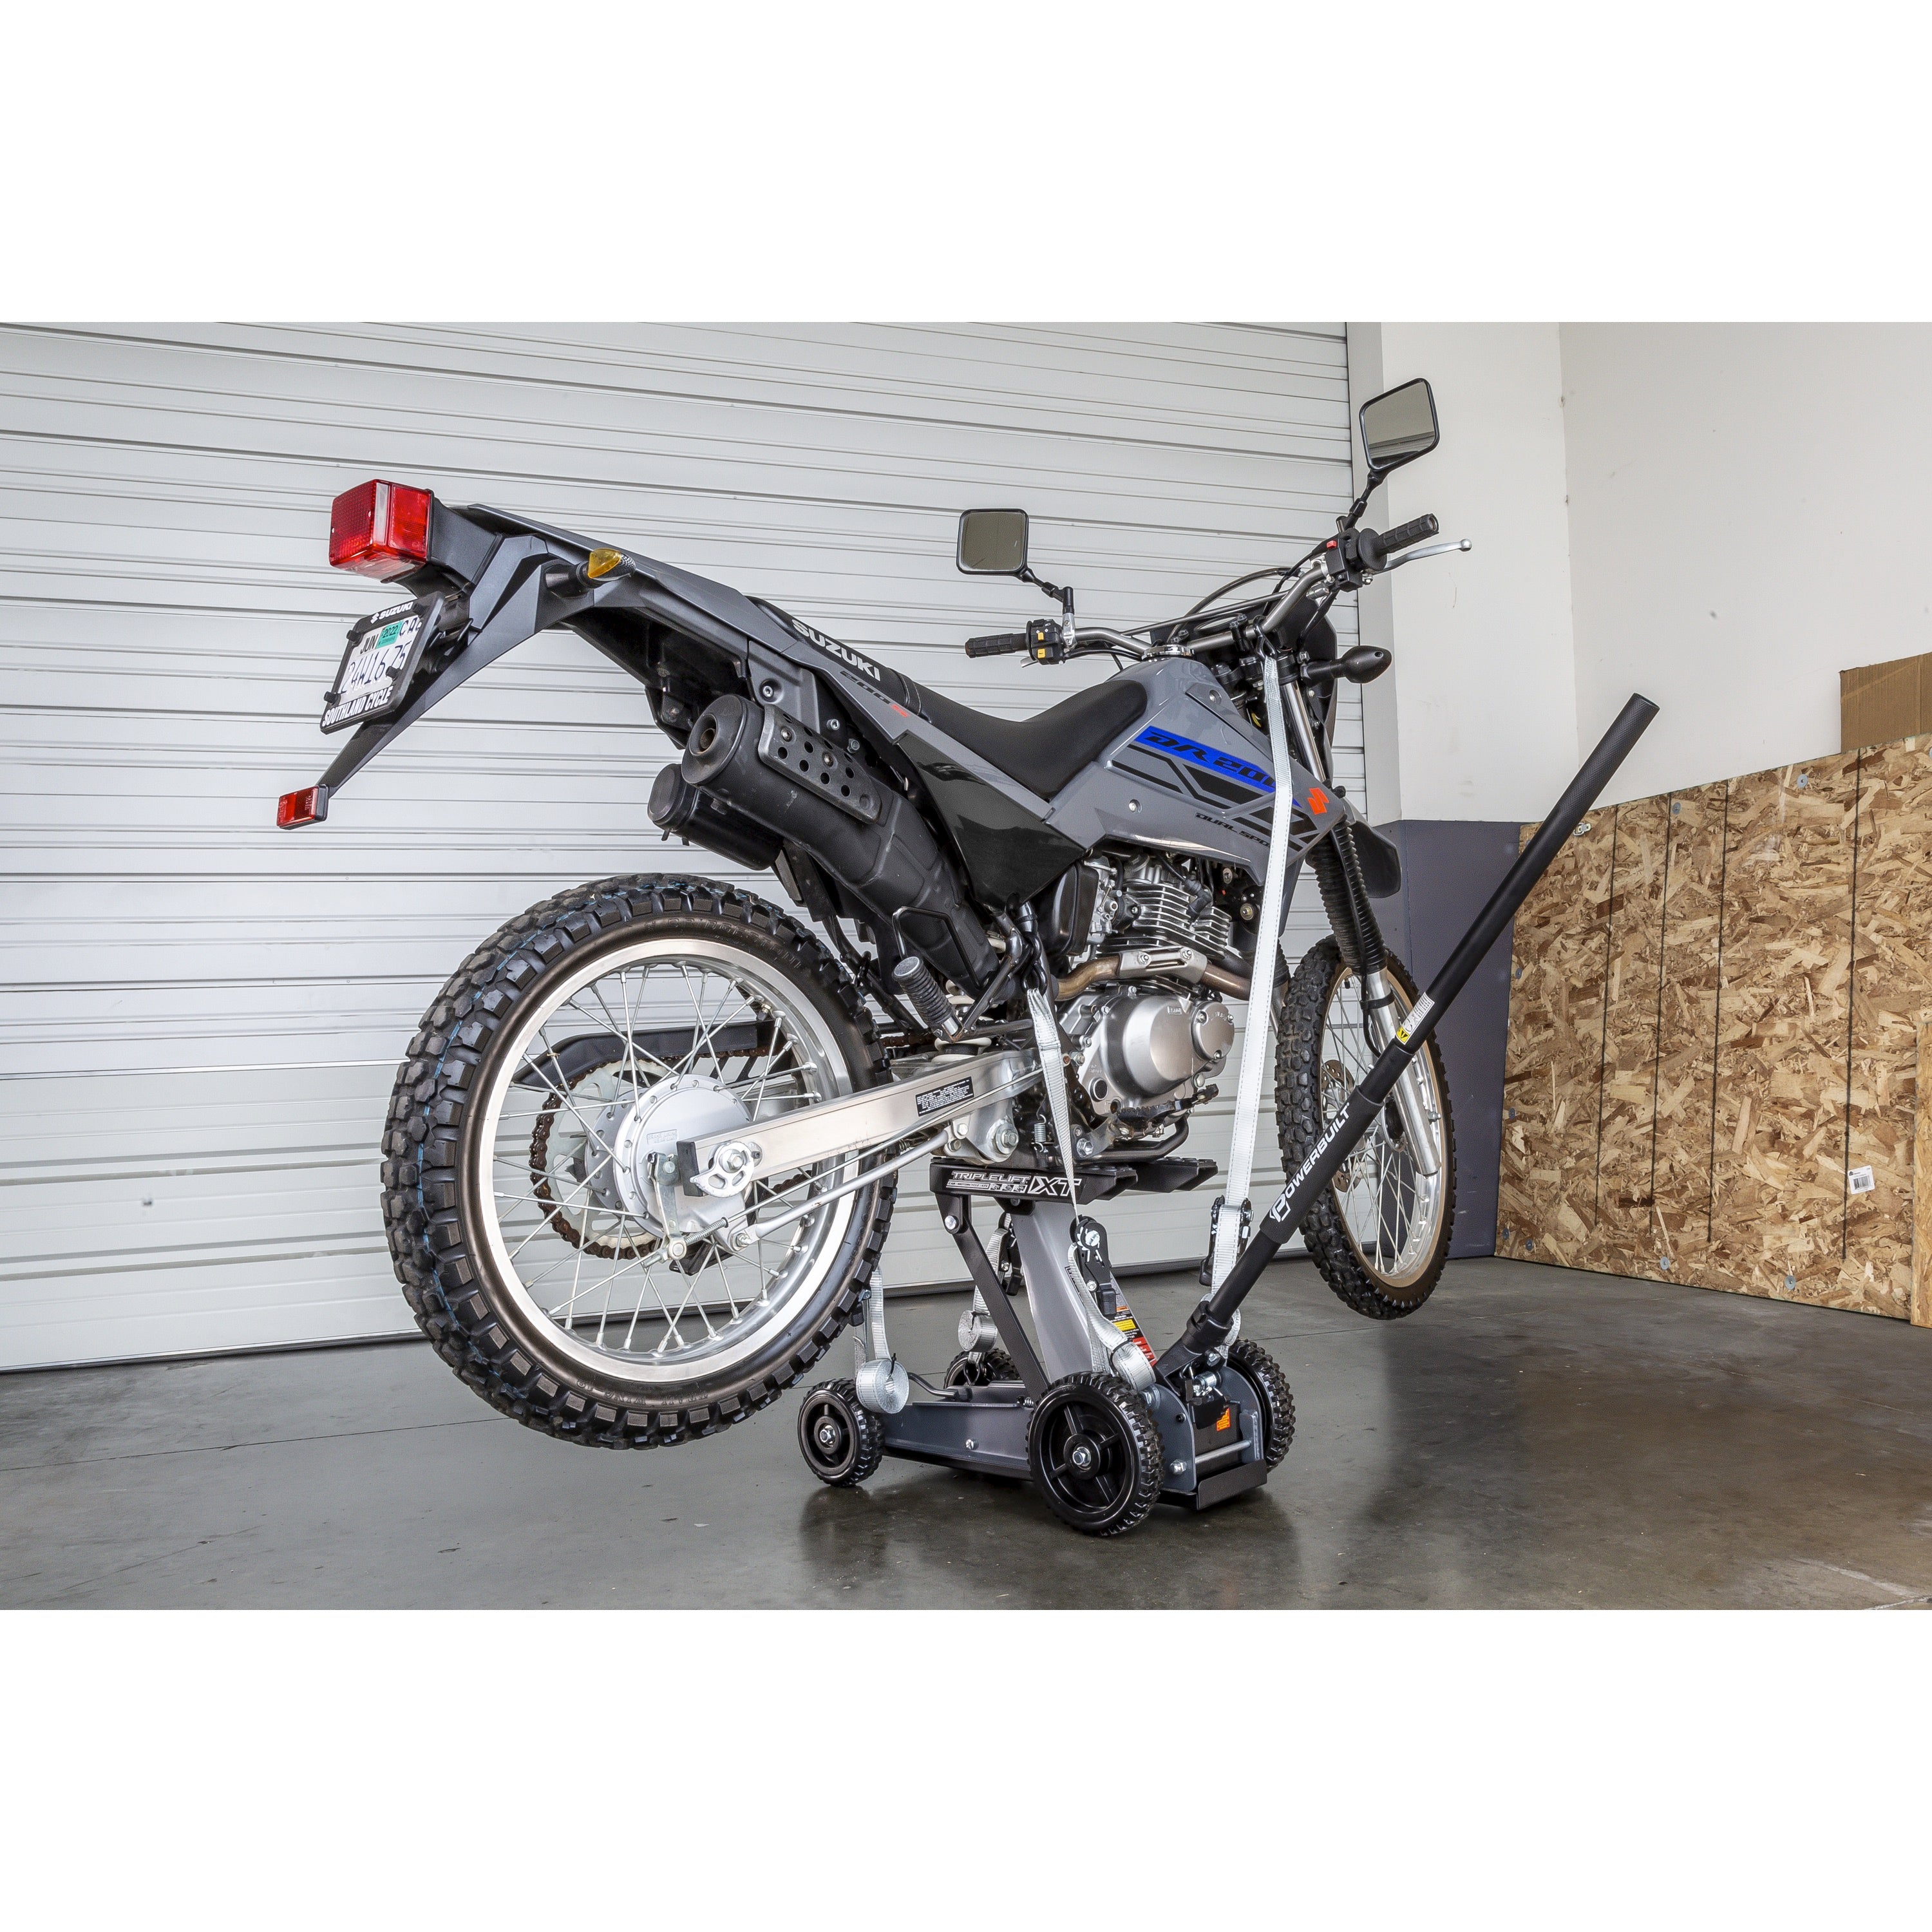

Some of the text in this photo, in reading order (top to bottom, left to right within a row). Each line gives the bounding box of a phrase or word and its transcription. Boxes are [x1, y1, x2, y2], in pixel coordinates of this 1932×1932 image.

[379, 601, 414, 620] SUZUKI
[382, 625, 399, 639] 2022
[360, 634, 379, 654] JUN
[791, 619, 881, 681] SUZUKI
[322, 685, 394, 727] SOUTHLAND CYCLE
[1195, 812, 1238, 833] DUAL
[1269, 1105, 1350, 1223] POWERBUILT
[951, 1170, 1031, 1184] TRIPLELIFT
